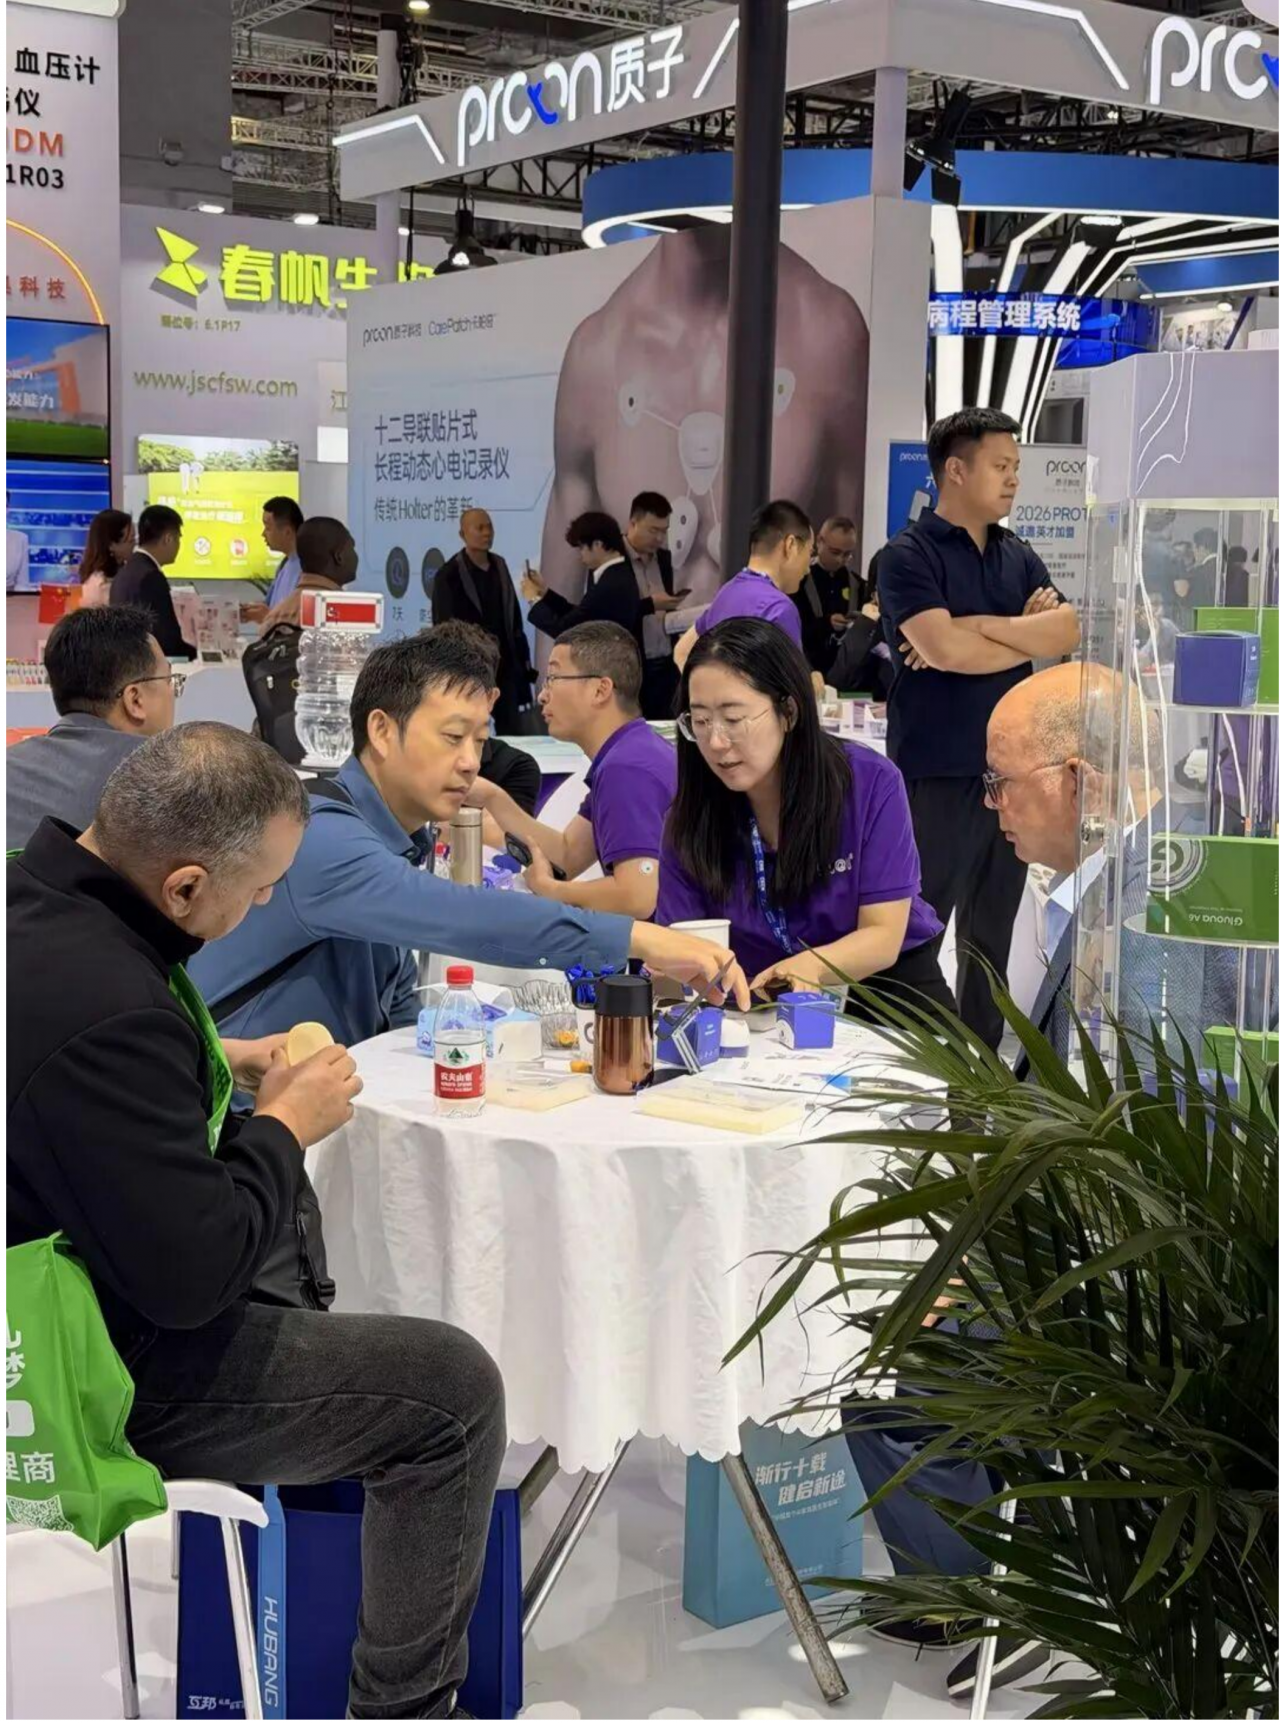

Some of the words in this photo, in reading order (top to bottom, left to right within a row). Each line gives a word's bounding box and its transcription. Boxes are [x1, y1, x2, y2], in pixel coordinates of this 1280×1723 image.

[14, 47, 101, 85] 血压计
[608, 25, 684, 111] 质子
[6, 127, 65, 158] DM
[927, 300, 1081, 331] 病程管理系统
[134, 370, 298, 397] www.jscfsw.com
[375, 409, 478, 445] 十二导联贴片式
[375, 447, 510, 483] 长程动态心电记录仪
[778, 1469, 847, 1506] 健启新途
[263, 1597, 279, 1708] HUBANG
[187, 1695, 217, 1710] 互邦
